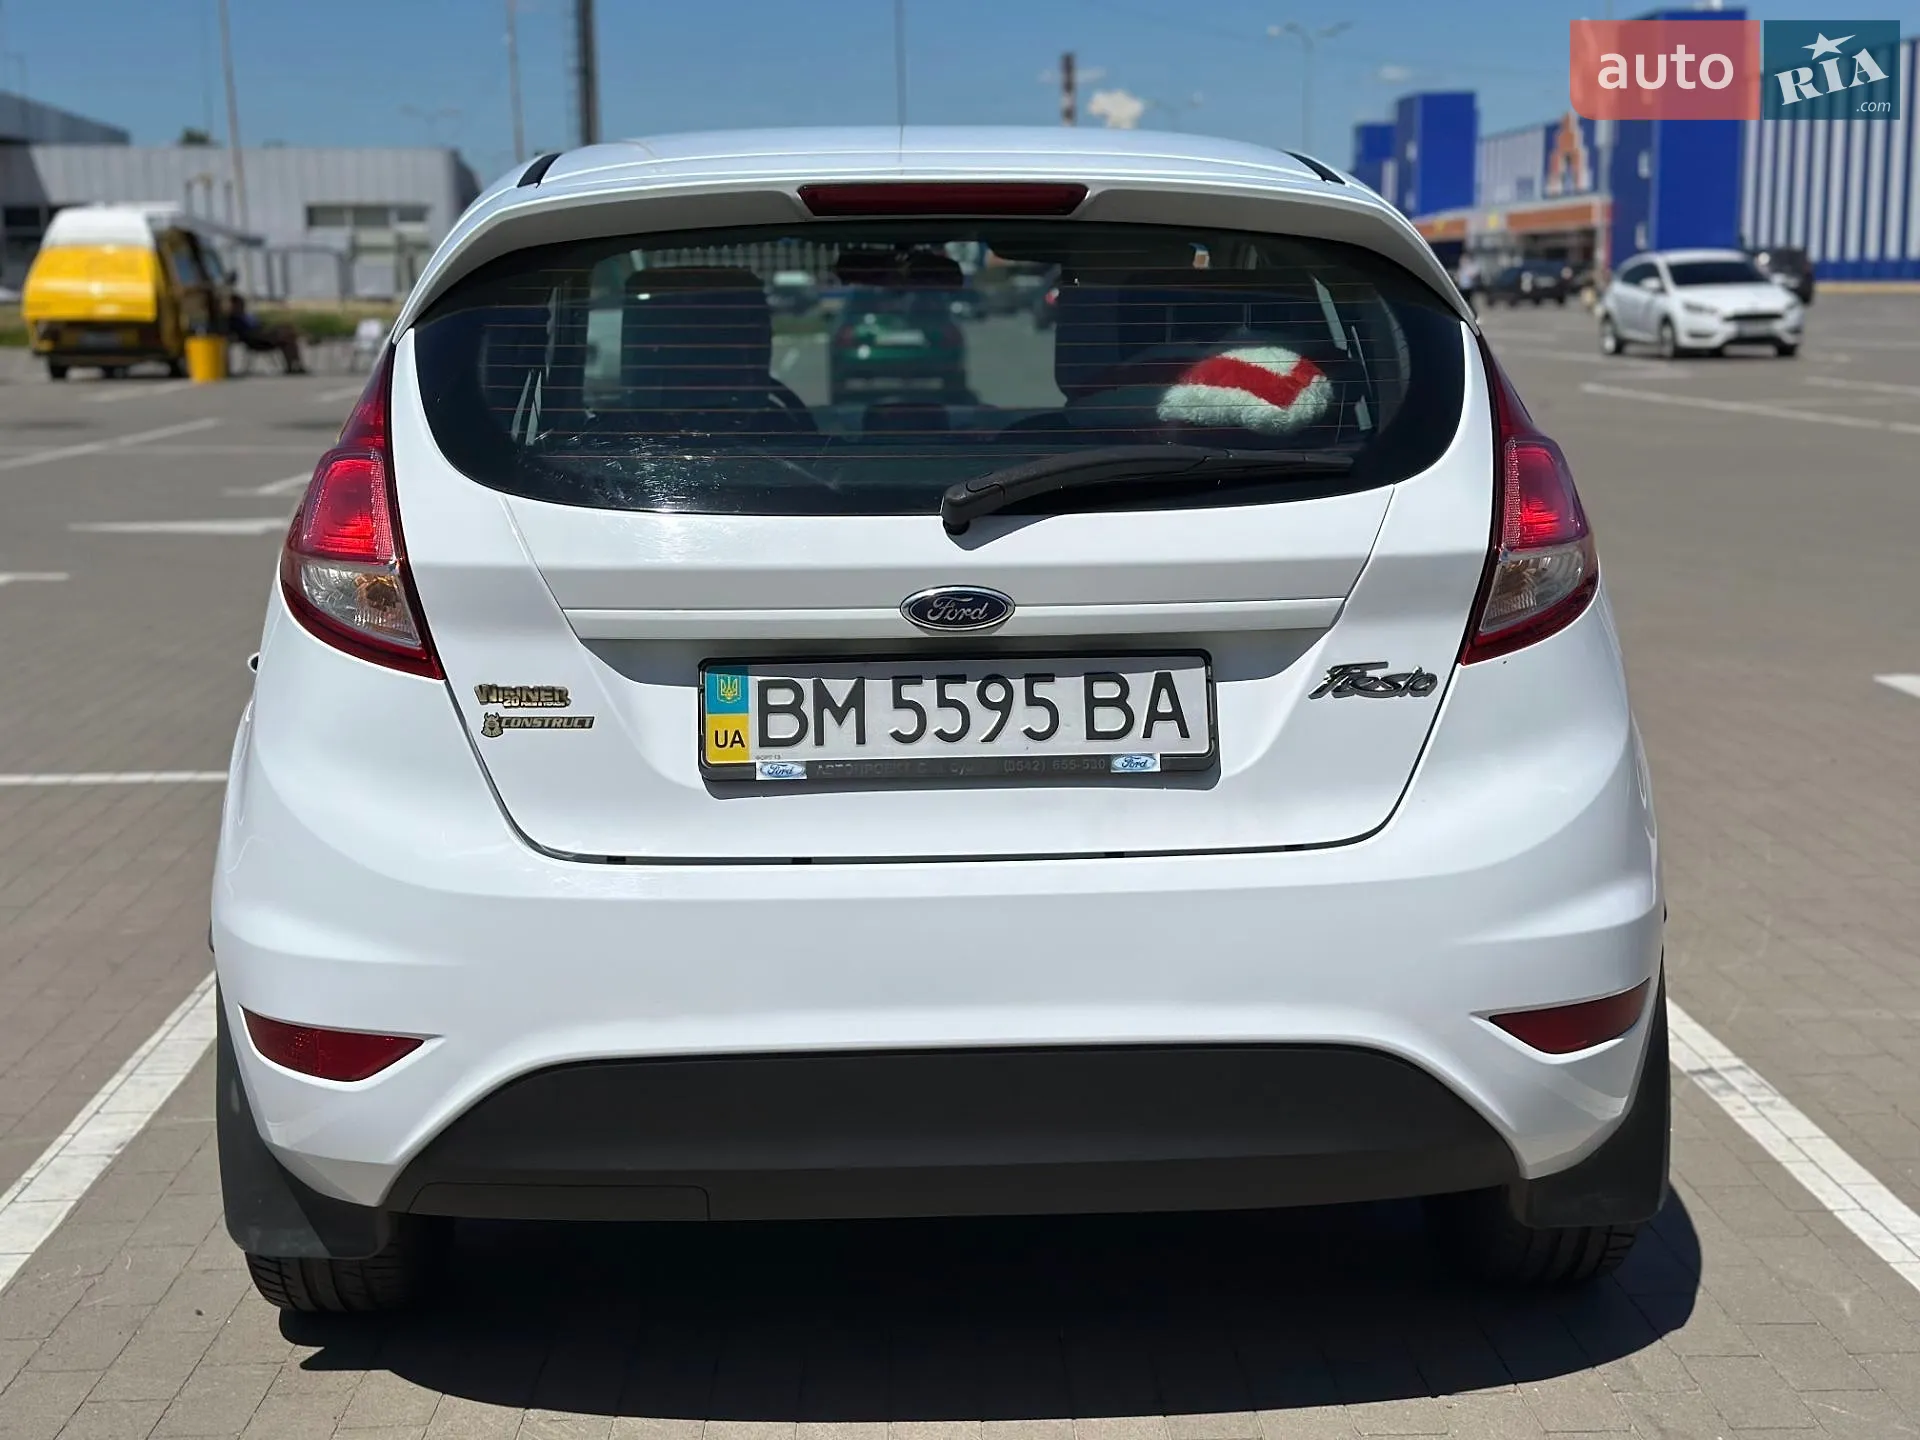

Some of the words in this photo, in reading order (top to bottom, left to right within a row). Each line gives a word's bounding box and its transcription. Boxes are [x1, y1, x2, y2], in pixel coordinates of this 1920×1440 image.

[926, 596, 989, 621] Ford
[1308, 661, 1438, 699] Fiesta
[758, 677, 866, 748] BM
[889, 673, 1060, 744] 5595
[1083, 671, 1191, 741] BA
[500, 717, 593, 728] CONSTRUCT
[714, 729, 746, 748] UA
